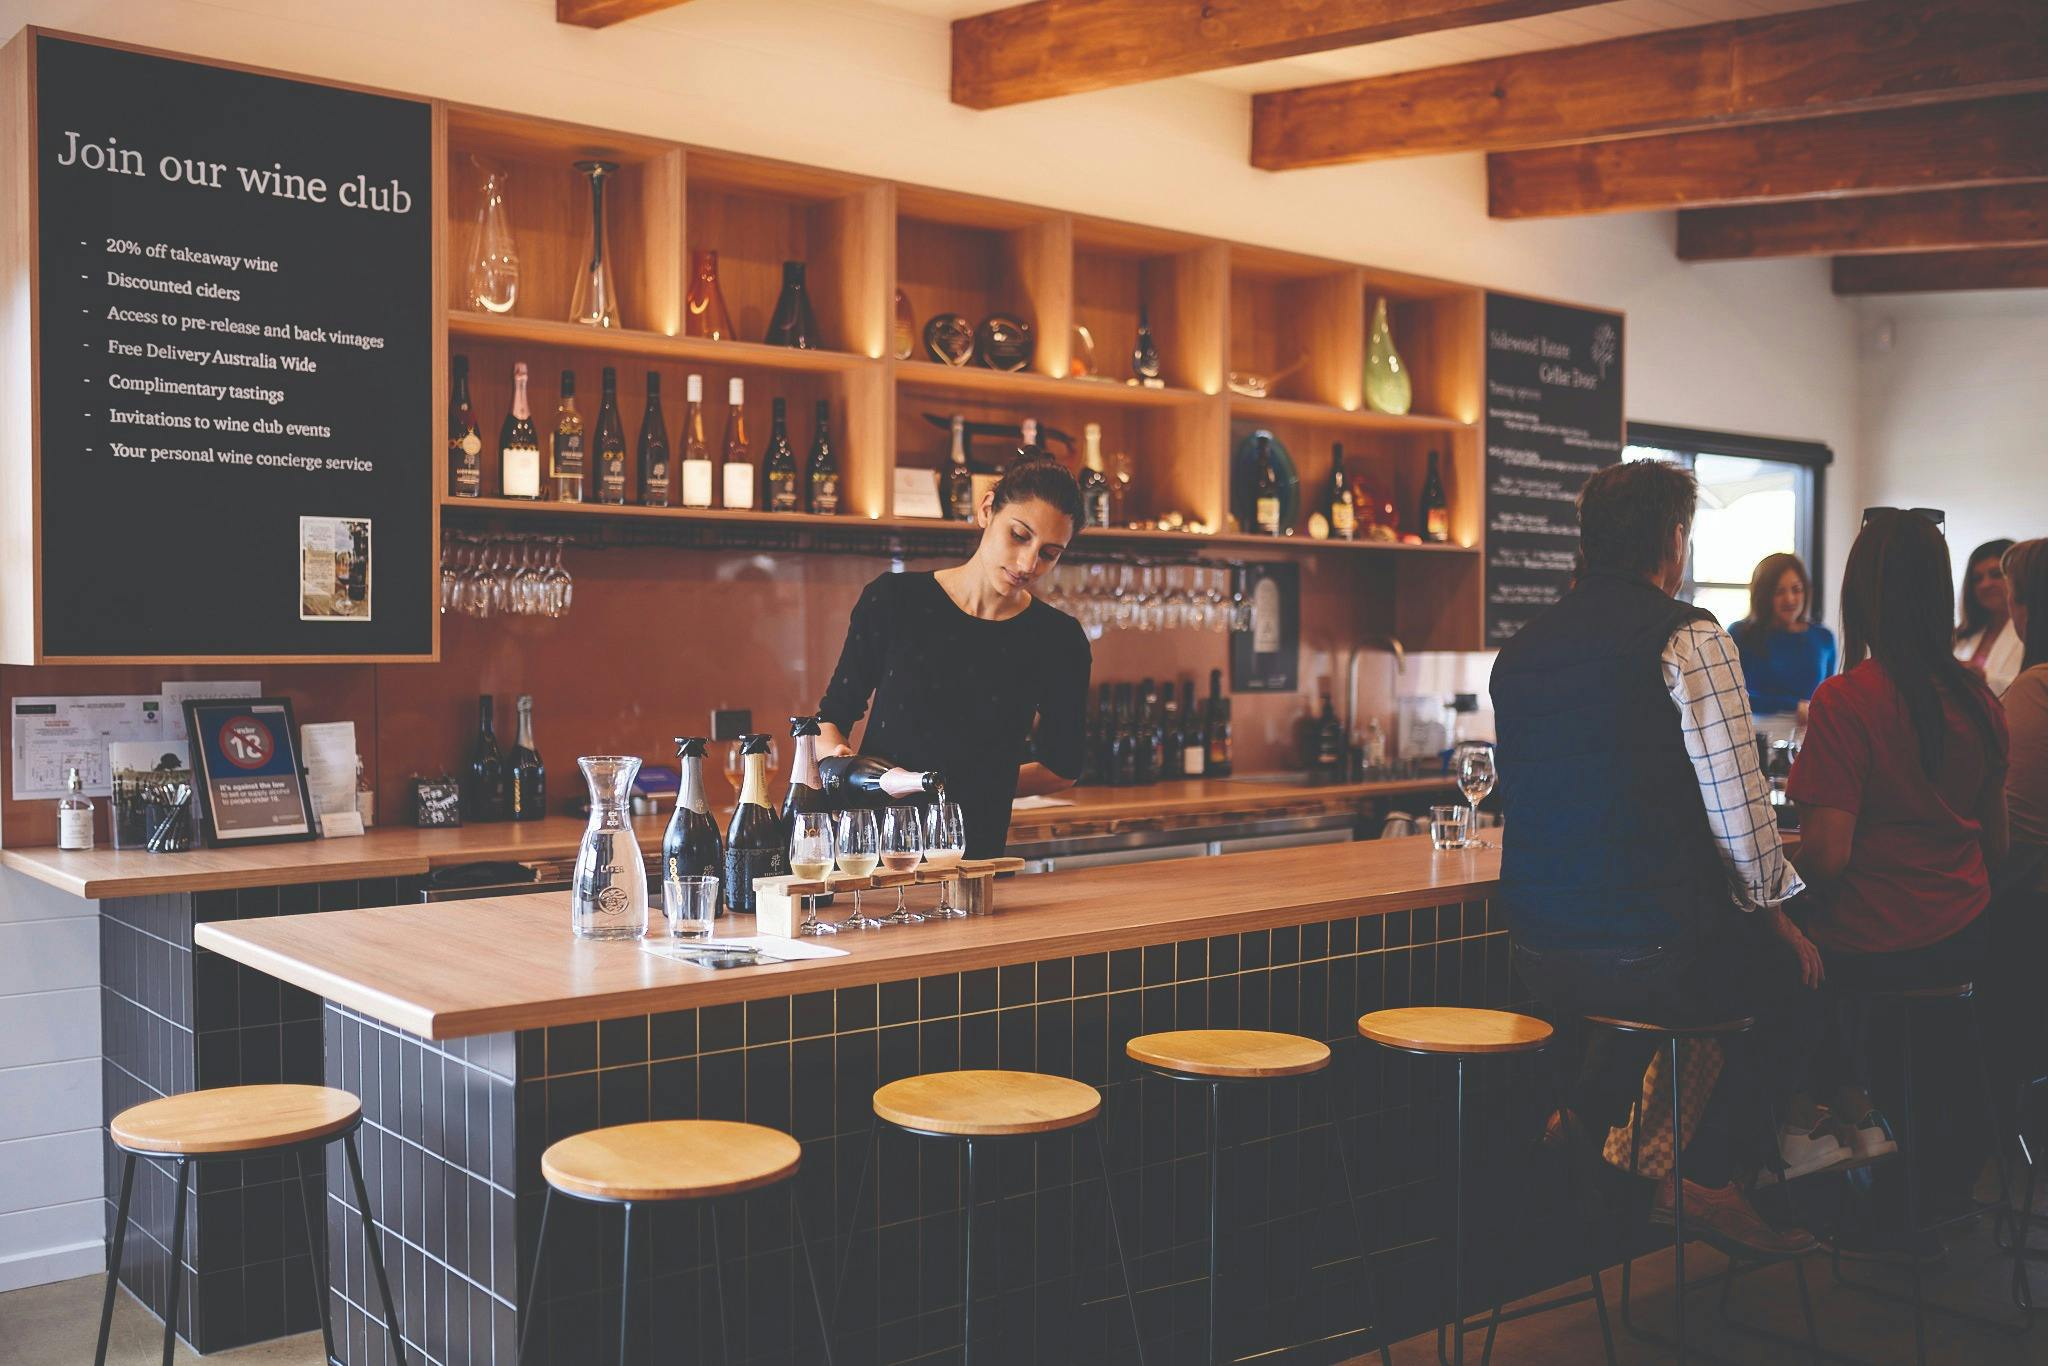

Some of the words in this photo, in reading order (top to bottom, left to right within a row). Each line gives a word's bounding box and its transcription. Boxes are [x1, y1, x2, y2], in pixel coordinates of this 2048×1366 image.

[58, 131, 145, 176] Join
[159, 156, 226, 188] our
[237, 163, 327, 203] wine
[339, 175, 412, 213] club
[106, 238, 141, 256] 20%
[146, 244, 168, 258] off
[170, 247, 241, 270] takeaway
[243, 258, 278, 272] wine
[107, 272, 192, 295] Discounted
[196, 284, 240, 301] ciders
[107, 306, 158, 324] Access
[162, 312, 177, 326] to
[181, 316, 260, 335] pre-release
[264, 323, 290, 339] and
[294, 325, 326, 342] back
[329, 331, 384, 350] vintages
[108, 340, 142, 356] Free
[147, 343, 211, 365] Delivery
[212, 350, 277, 370] Australia
[280, 356, 317, 372] Wide
[108, 374, 226, 400] Complimentary
[229, 386, 284, 404] tastings
[109, 409, 191, 428] Invitations
[195, 416, 210, 429] to
[214, 416, 249, 432] wine
[253, 419, 283, 434] club
[286, 422, 330, 438] events
[110, 443, 147, 458] Your
[150, 447, 214, 462] personal
[217, 451, 253, 465] wine
[256, 452, 322, 471] concierge
[326, 457, 373, 472] service
[230, 734, 263, 759] 18
[233, 782, 259, 791] against
